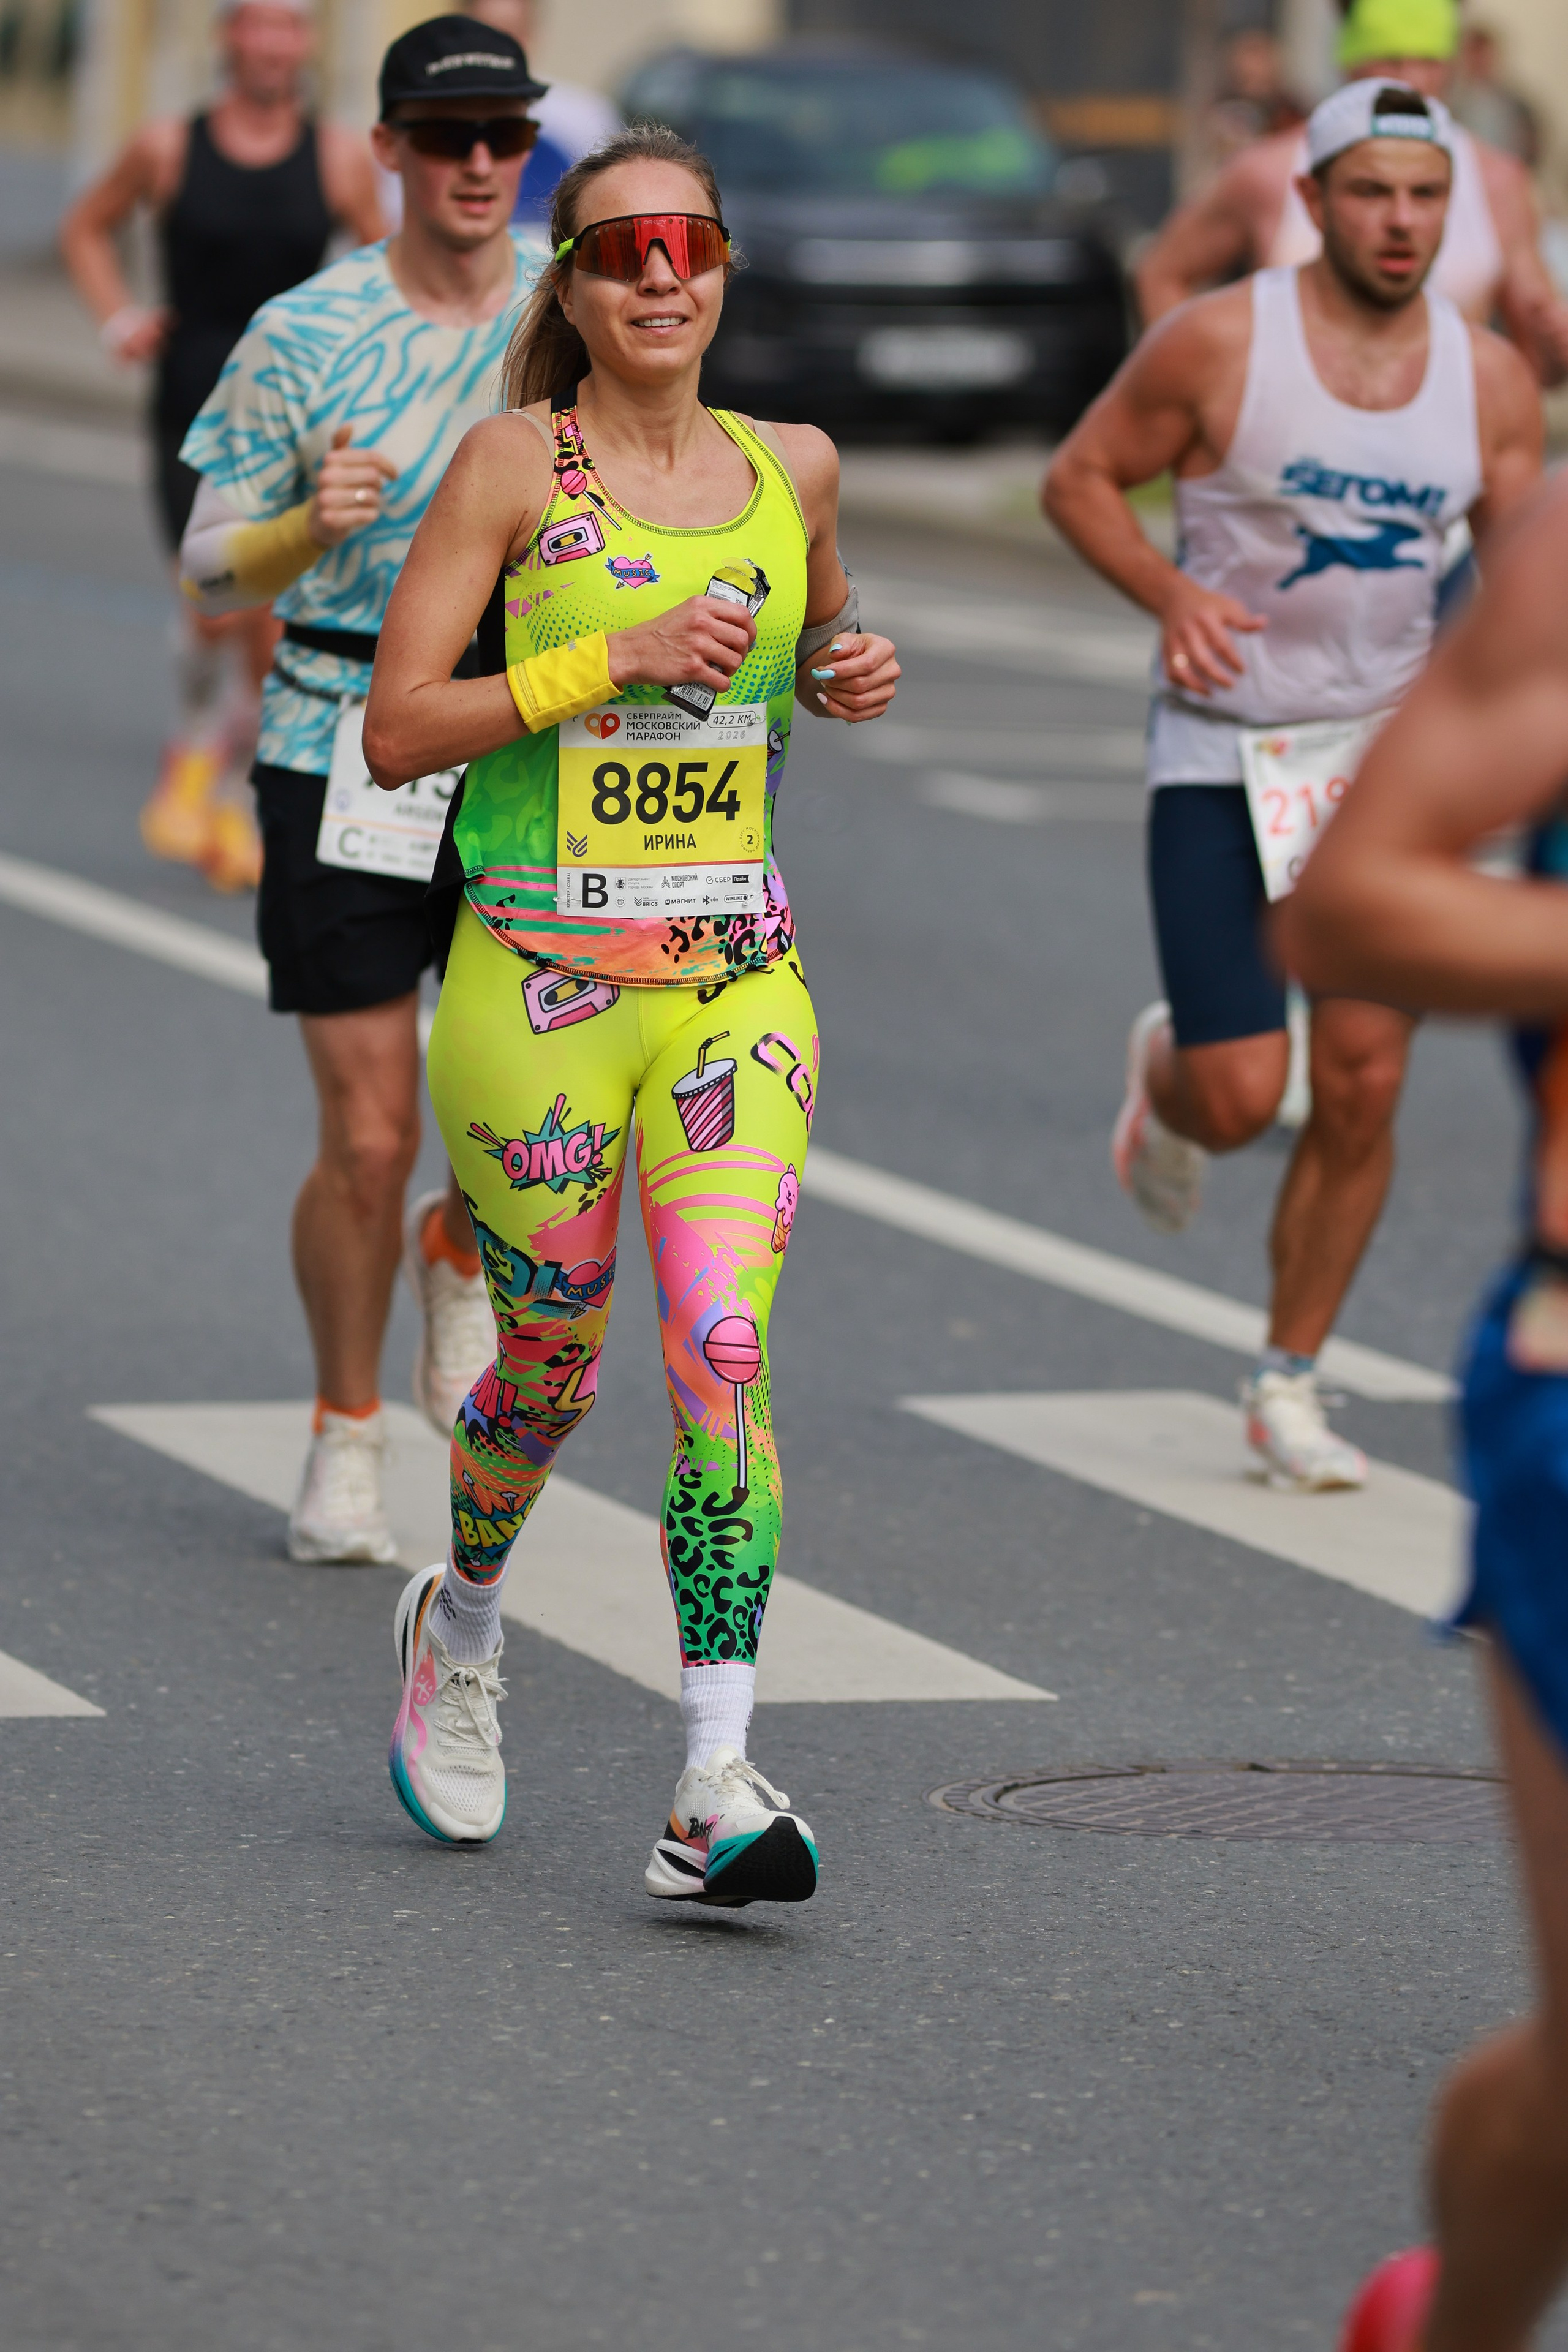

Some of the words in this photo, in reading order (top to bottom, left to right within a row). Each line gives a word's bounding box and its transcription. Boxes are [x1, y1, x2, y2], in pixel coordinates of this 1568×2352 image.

[627, 720, 701, 730] МОСКОВСКИЙ
[712, 715, 734, 726] 42,2
[627, 732, 680, 741] МАРАФОН
[717, 729, 745, 740] 2026
[591, 760, 741, 825] 8854
[338, 827, 364, 859] C
[644, 833, 697, 851] ИРИНА
[747, 834, 753, 845] 2
[671, 873, 698, 882] МОСКОВСКИЙ
[502, 1122, 606, 1181] OMG!
[566, 1265, 615, 1297] MUSI
[457, 1488, 541, 1549] BAN
